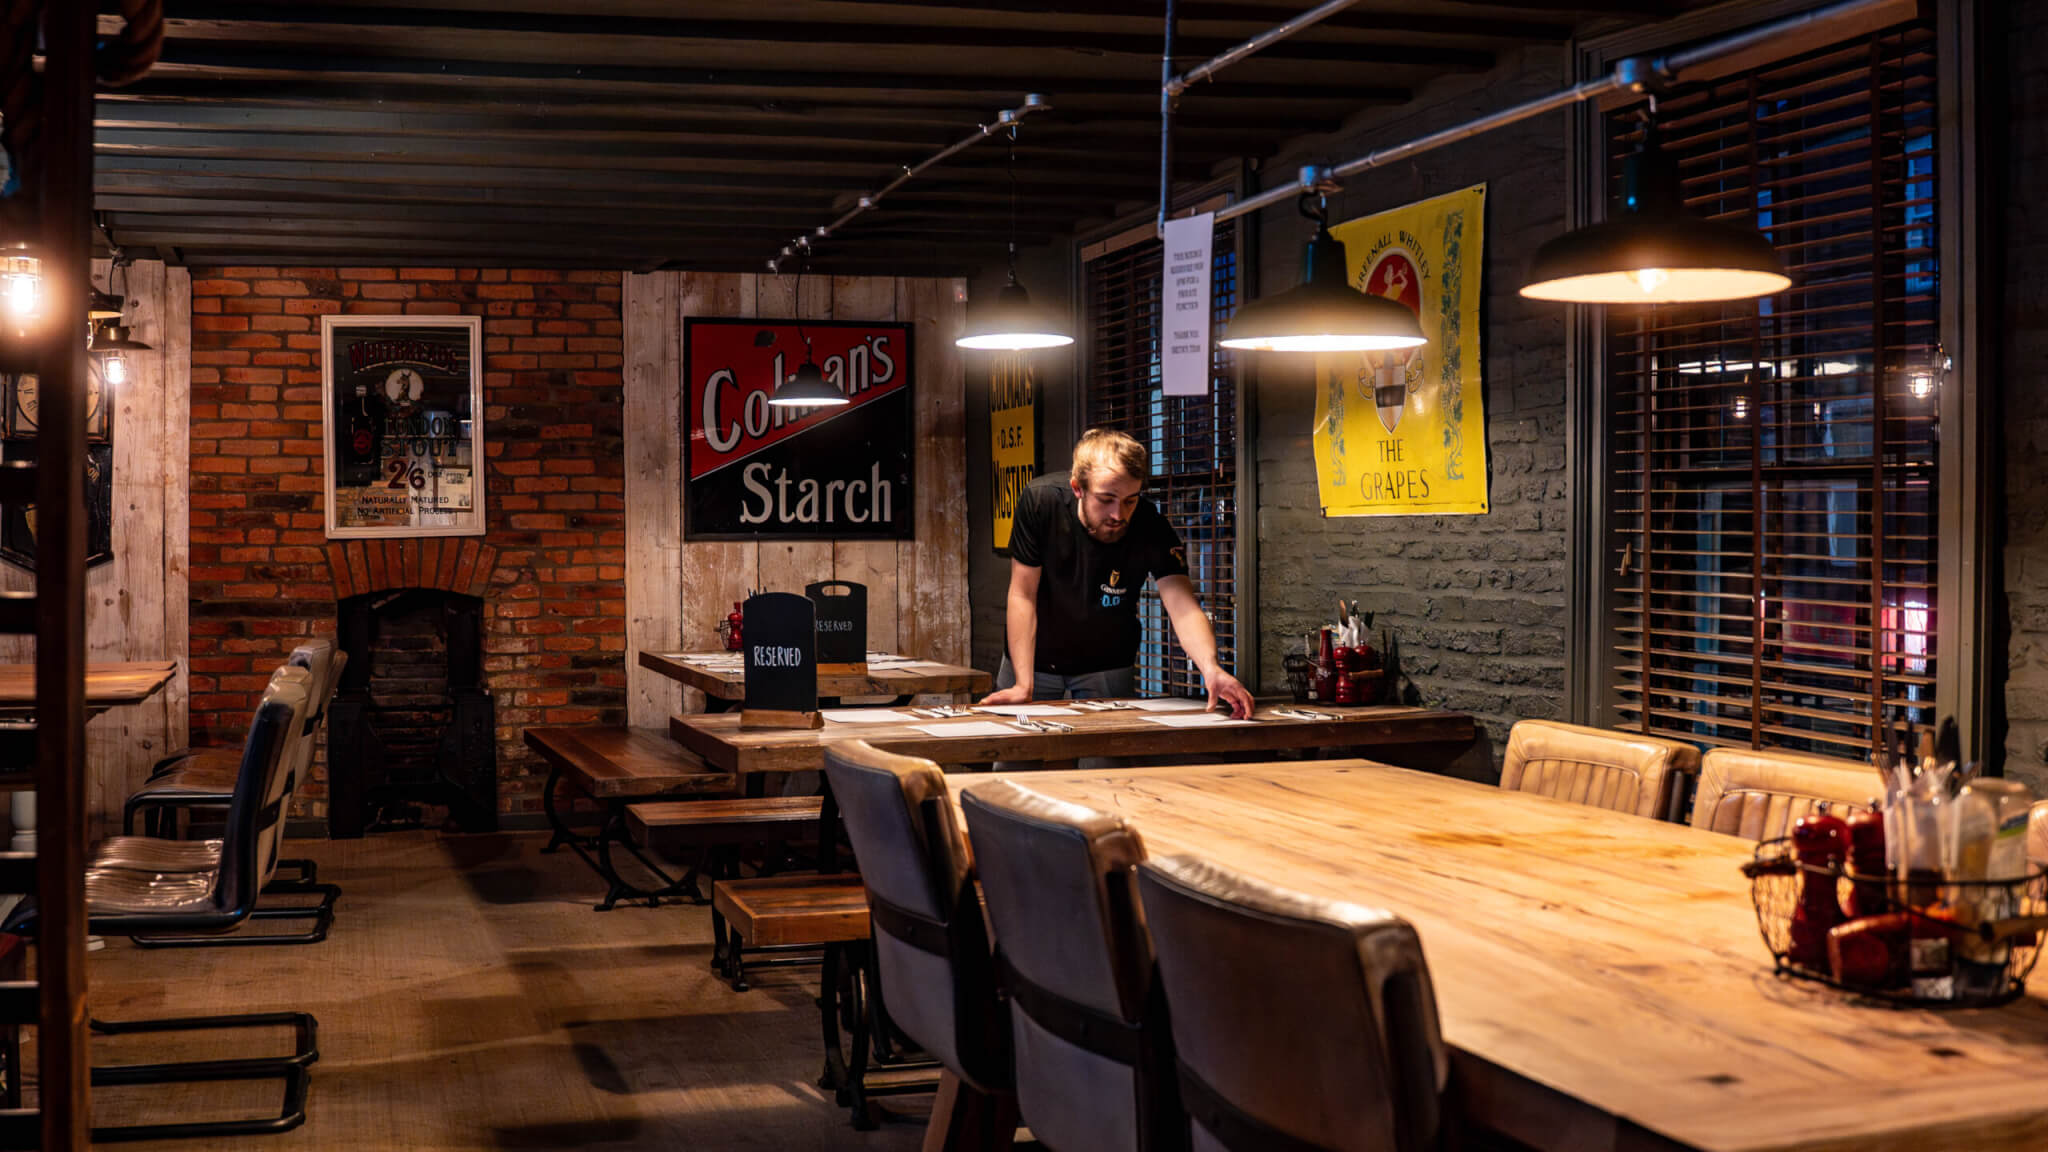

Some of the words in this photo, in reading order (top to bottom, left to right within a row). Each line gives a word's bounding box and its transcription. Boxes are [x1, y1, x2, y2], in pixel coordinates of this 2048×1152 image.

[384, 417, 456, 436] LONDON
[381, 438, 457, 456] STOUT
[1377, 439, 1404, 462] THE
[388, 461, 426, 489] 2/6
[1361, 470, 1430, 500] GRAPES
[740, 461, 892, 523] Starch
[754, 645, 802, 667] RESERVED
